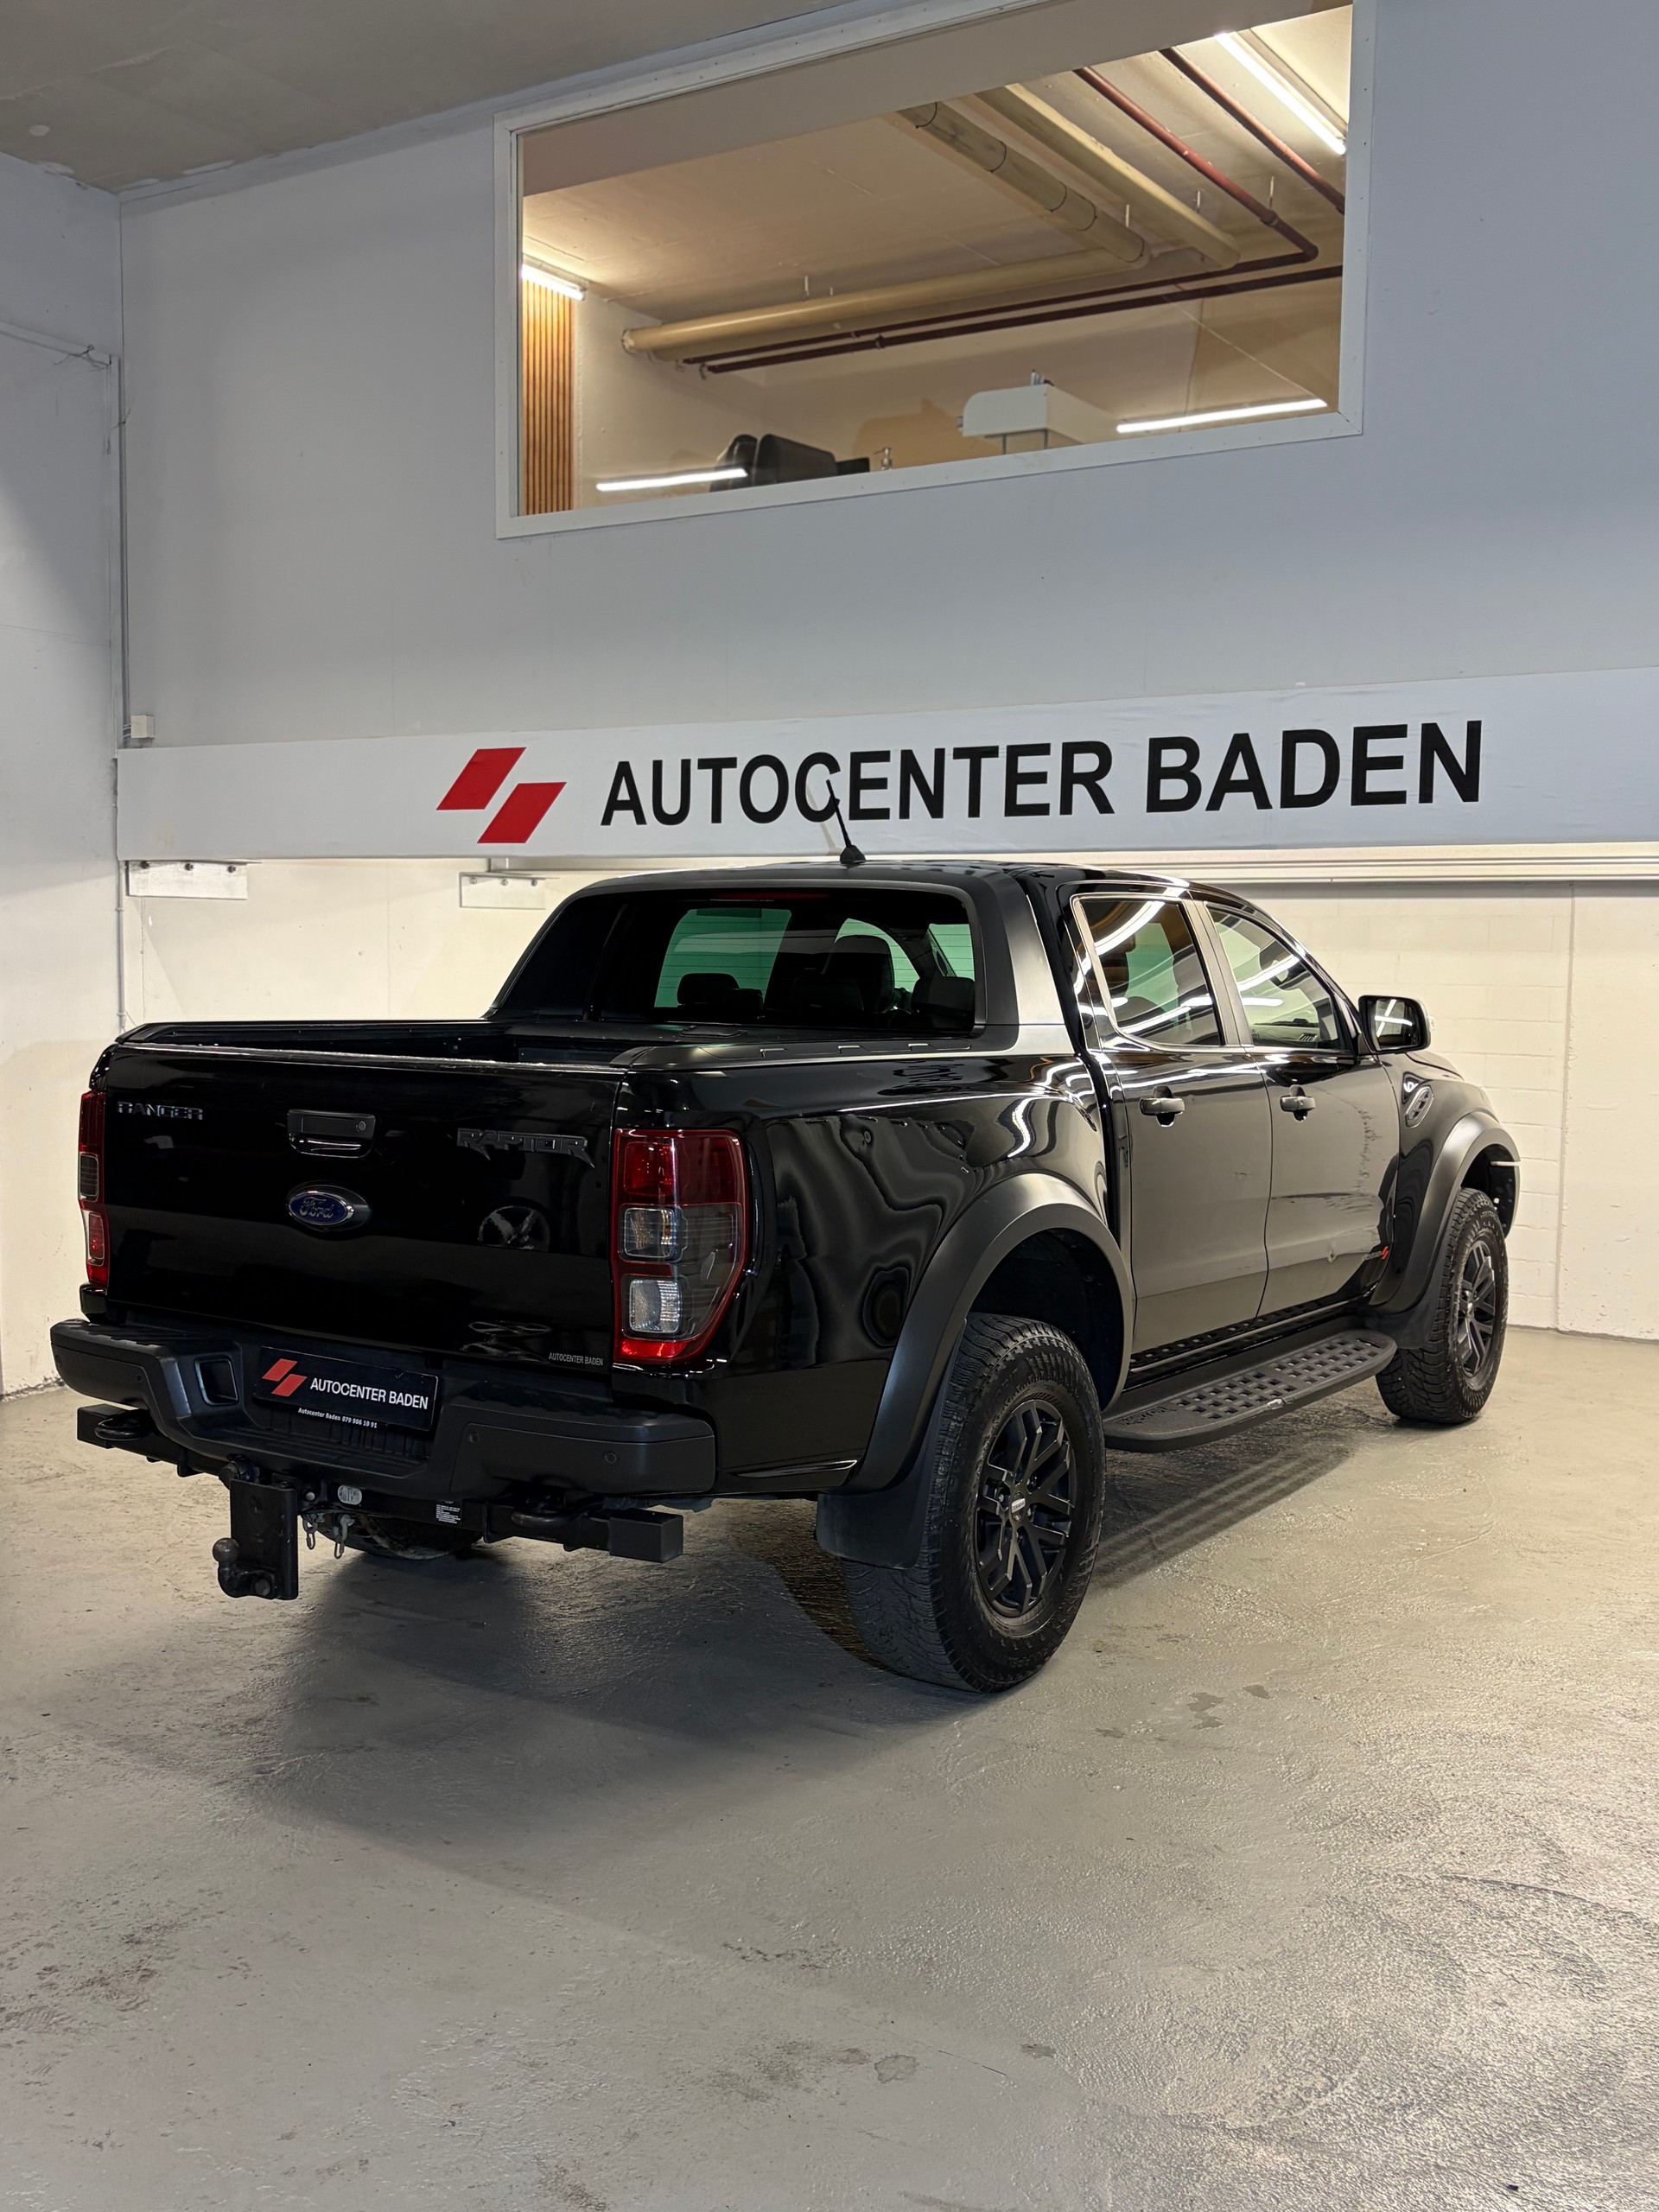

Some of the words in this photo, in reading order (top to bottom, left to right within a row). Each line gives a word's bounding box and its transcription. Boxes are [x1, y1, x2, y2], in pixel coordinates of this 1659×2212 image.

[601, 740, 1115, 827] AUTOCENTER
[1146, 720, 1483, 813] BADEN
[456, 1128, 595, 1169] RAPTOR
[299, 1196, 335, 1219] Ford
[549, 1352, 584, 1363] AUTOCENTER
[584, 1357, 604, 1366] BADEN
[310, 1378, 386, 1402] AUTOCENTER
[389, 1391, 429, 1409] BADEN
[298, 1408, 325, 1417] Autocenter
[325, 1412, 341, 1421] Baden
